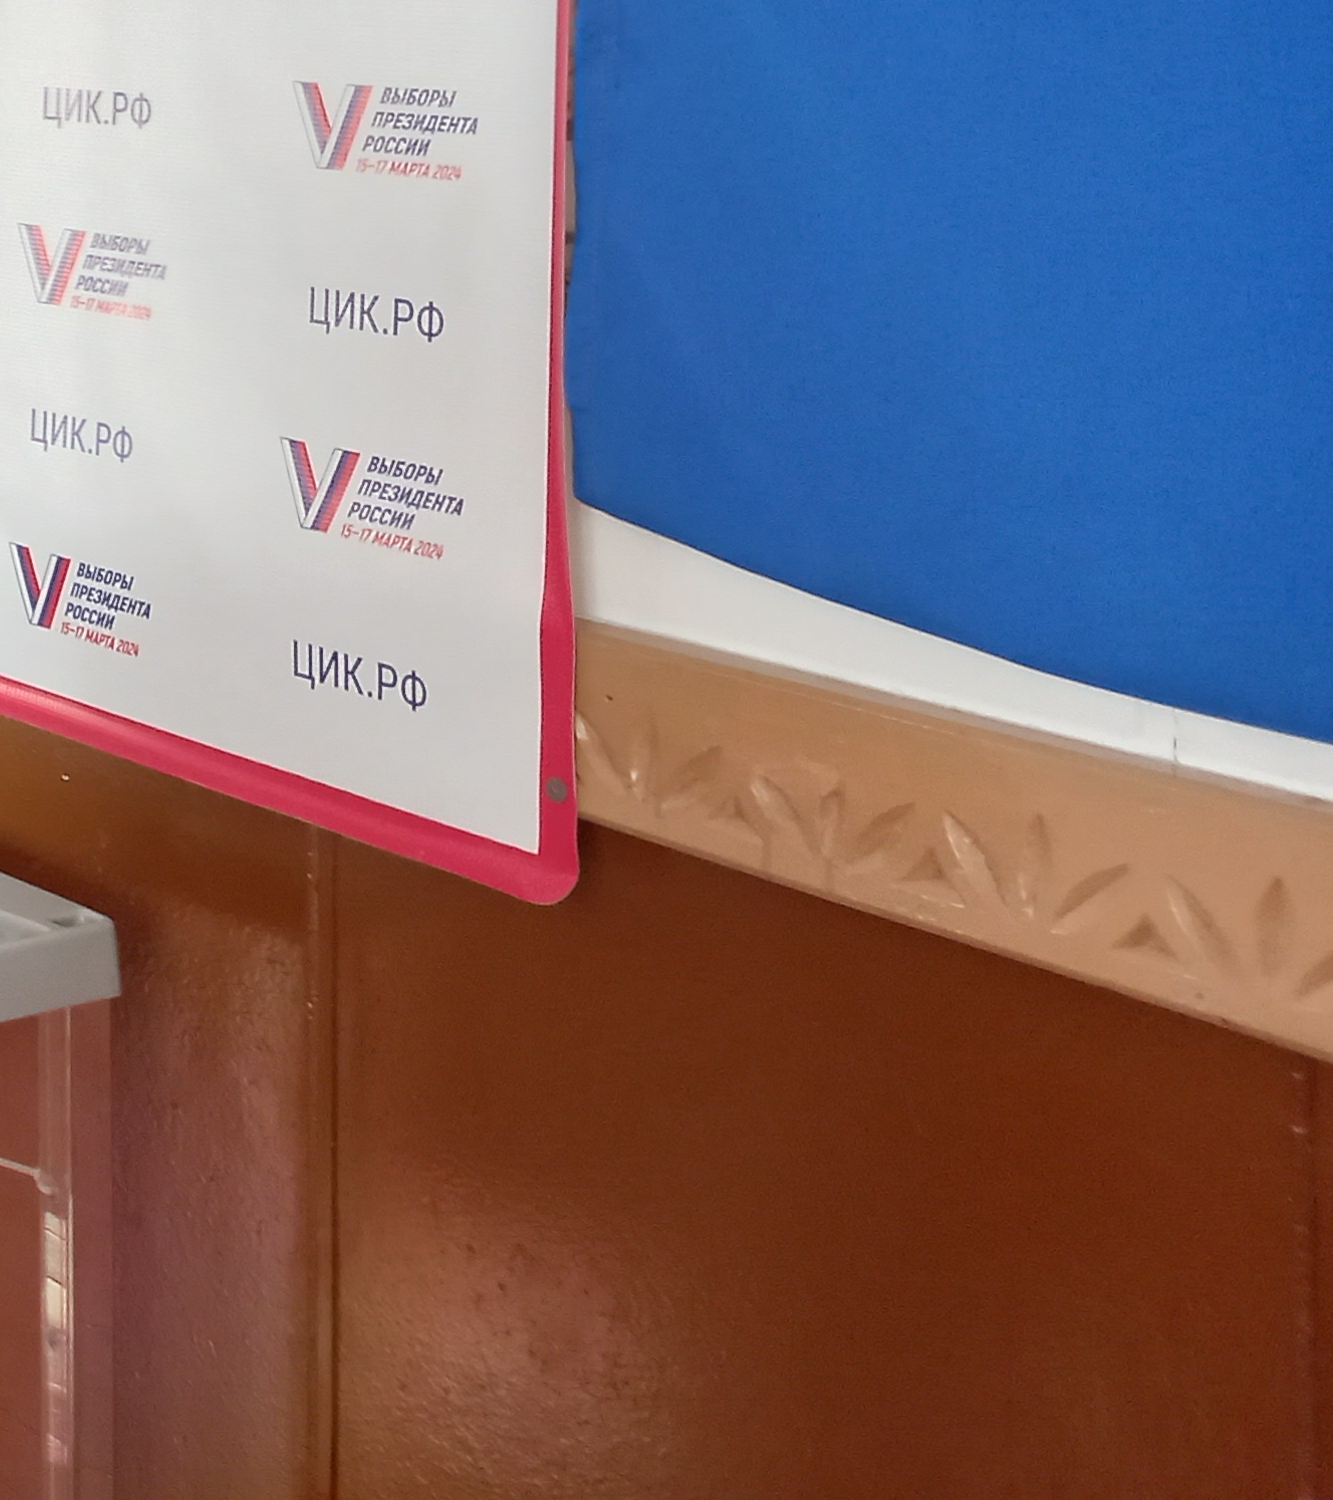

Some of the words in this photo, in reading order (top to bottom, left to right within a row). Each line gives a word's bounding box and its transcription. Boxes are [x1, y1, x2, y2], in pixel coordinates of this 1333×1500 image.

[43, 87, 151, 129] ЦИК.РФ
[379, 86, 458, 109] ВЫБОРЫ
[370, 110, 478, 136] ПРЕЗИДЕНТА
[360, 134, 430, 156] РОССИИ
[89, 232, 152, 255] ВЫБОРЫ
[310, 287, 444, 342] ЦИК.РФ
[31, 408, 133, 463] ЦИК.РФ
[366, 455, 445, 486] ВЫБОРЫ
[355, 478, 463, 517] ПРЕЗИДЕНТА
[345, 500, 414, 529] РОССИИ
[76, 562, 135, 592] ВЫБОРЫ
[63, 601, 115, 629] РОССИИ
[69, 582, 150, 619] ПРЕЗИДЕНТА
[293, 640, 426, 711] ЦИК.РФ
